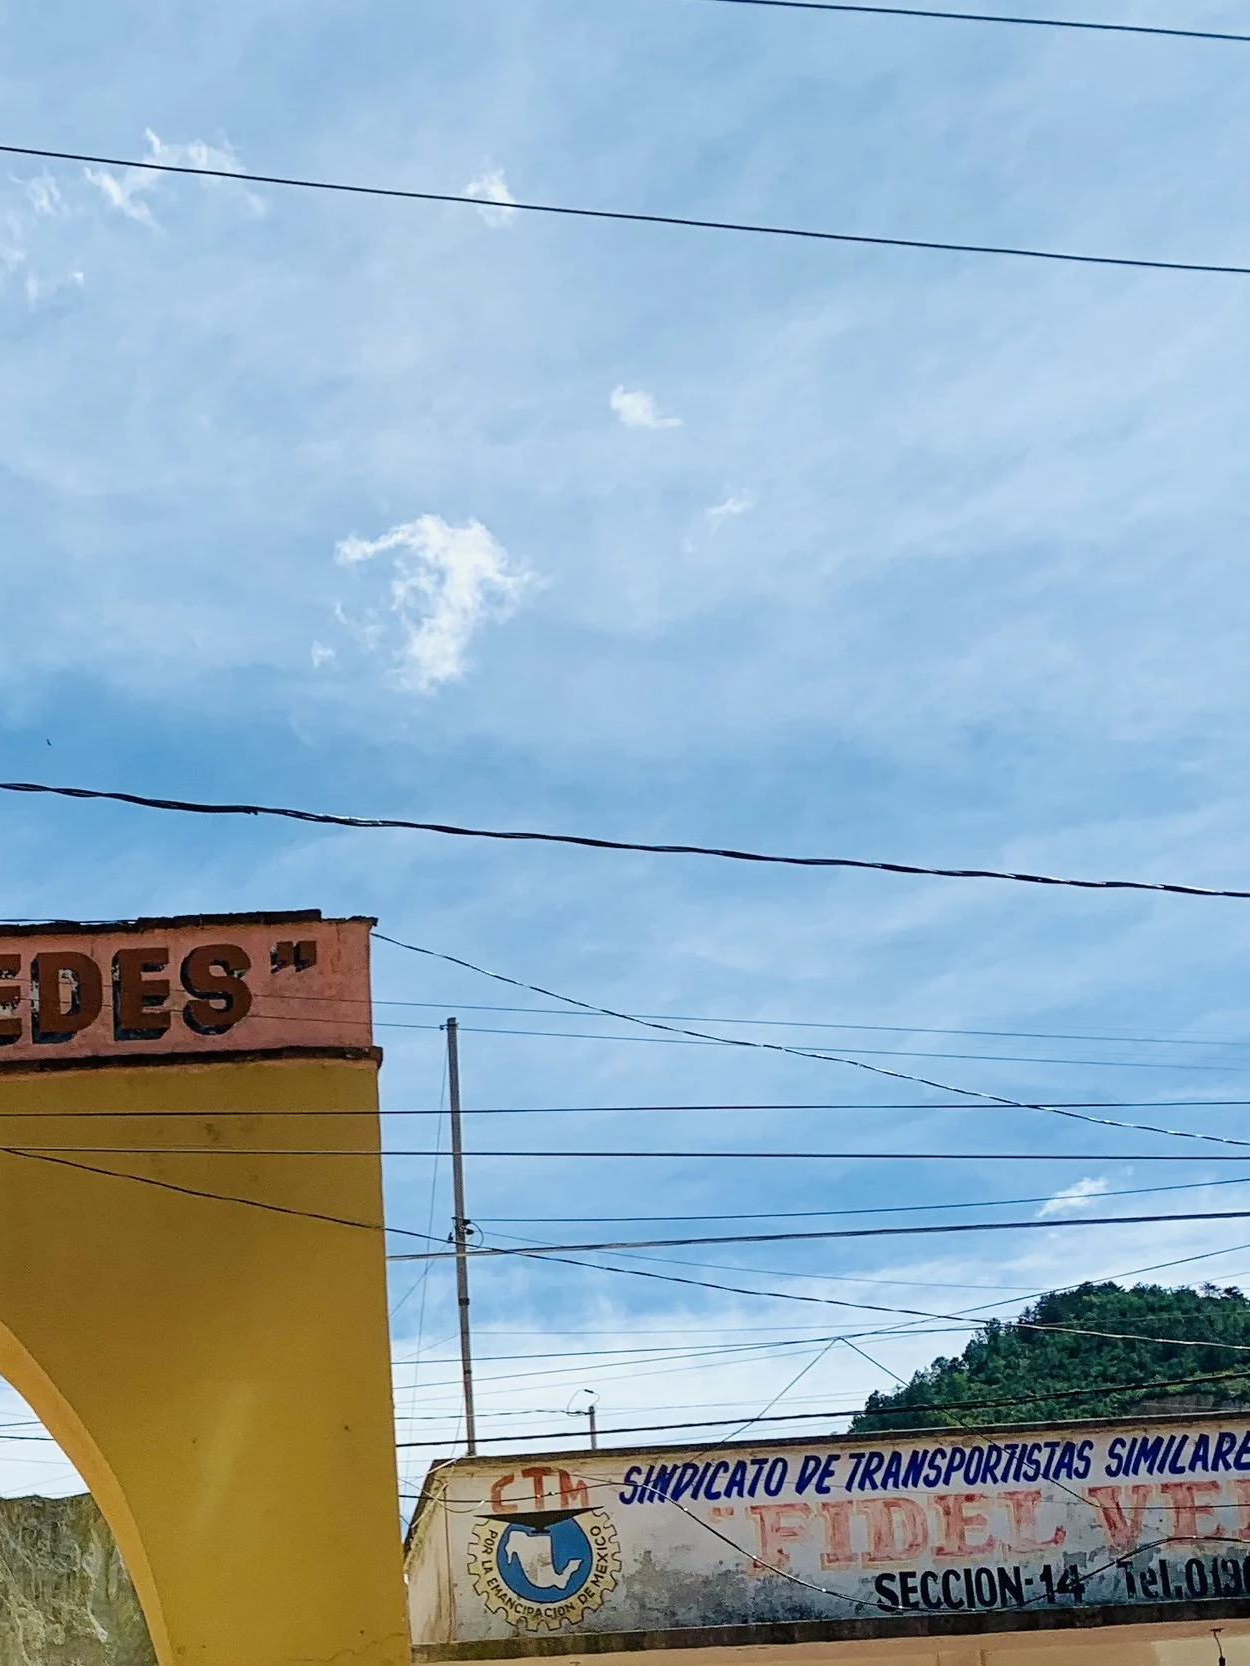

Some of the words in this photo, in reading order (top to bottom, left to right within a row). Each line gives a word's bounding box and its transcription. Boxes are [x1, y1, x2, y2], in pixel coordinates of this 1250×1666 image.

[490, 1466, 590, 1513] CTM
[619, 1456, 788, 1505] SINDICATO
[795, 1453, 842, 1496] DE
[845, 1439, 1094, 1491] TRANSPORTISTAS
[481, 1529, 499, 1559] POR
[590, 1525, 609, 1587] MEXICO
[481, 1560, 494, 1575] LA
[486, 1577, 577, 1618] EMANCIPACION
[579, 1590, 596, 1606] DE
